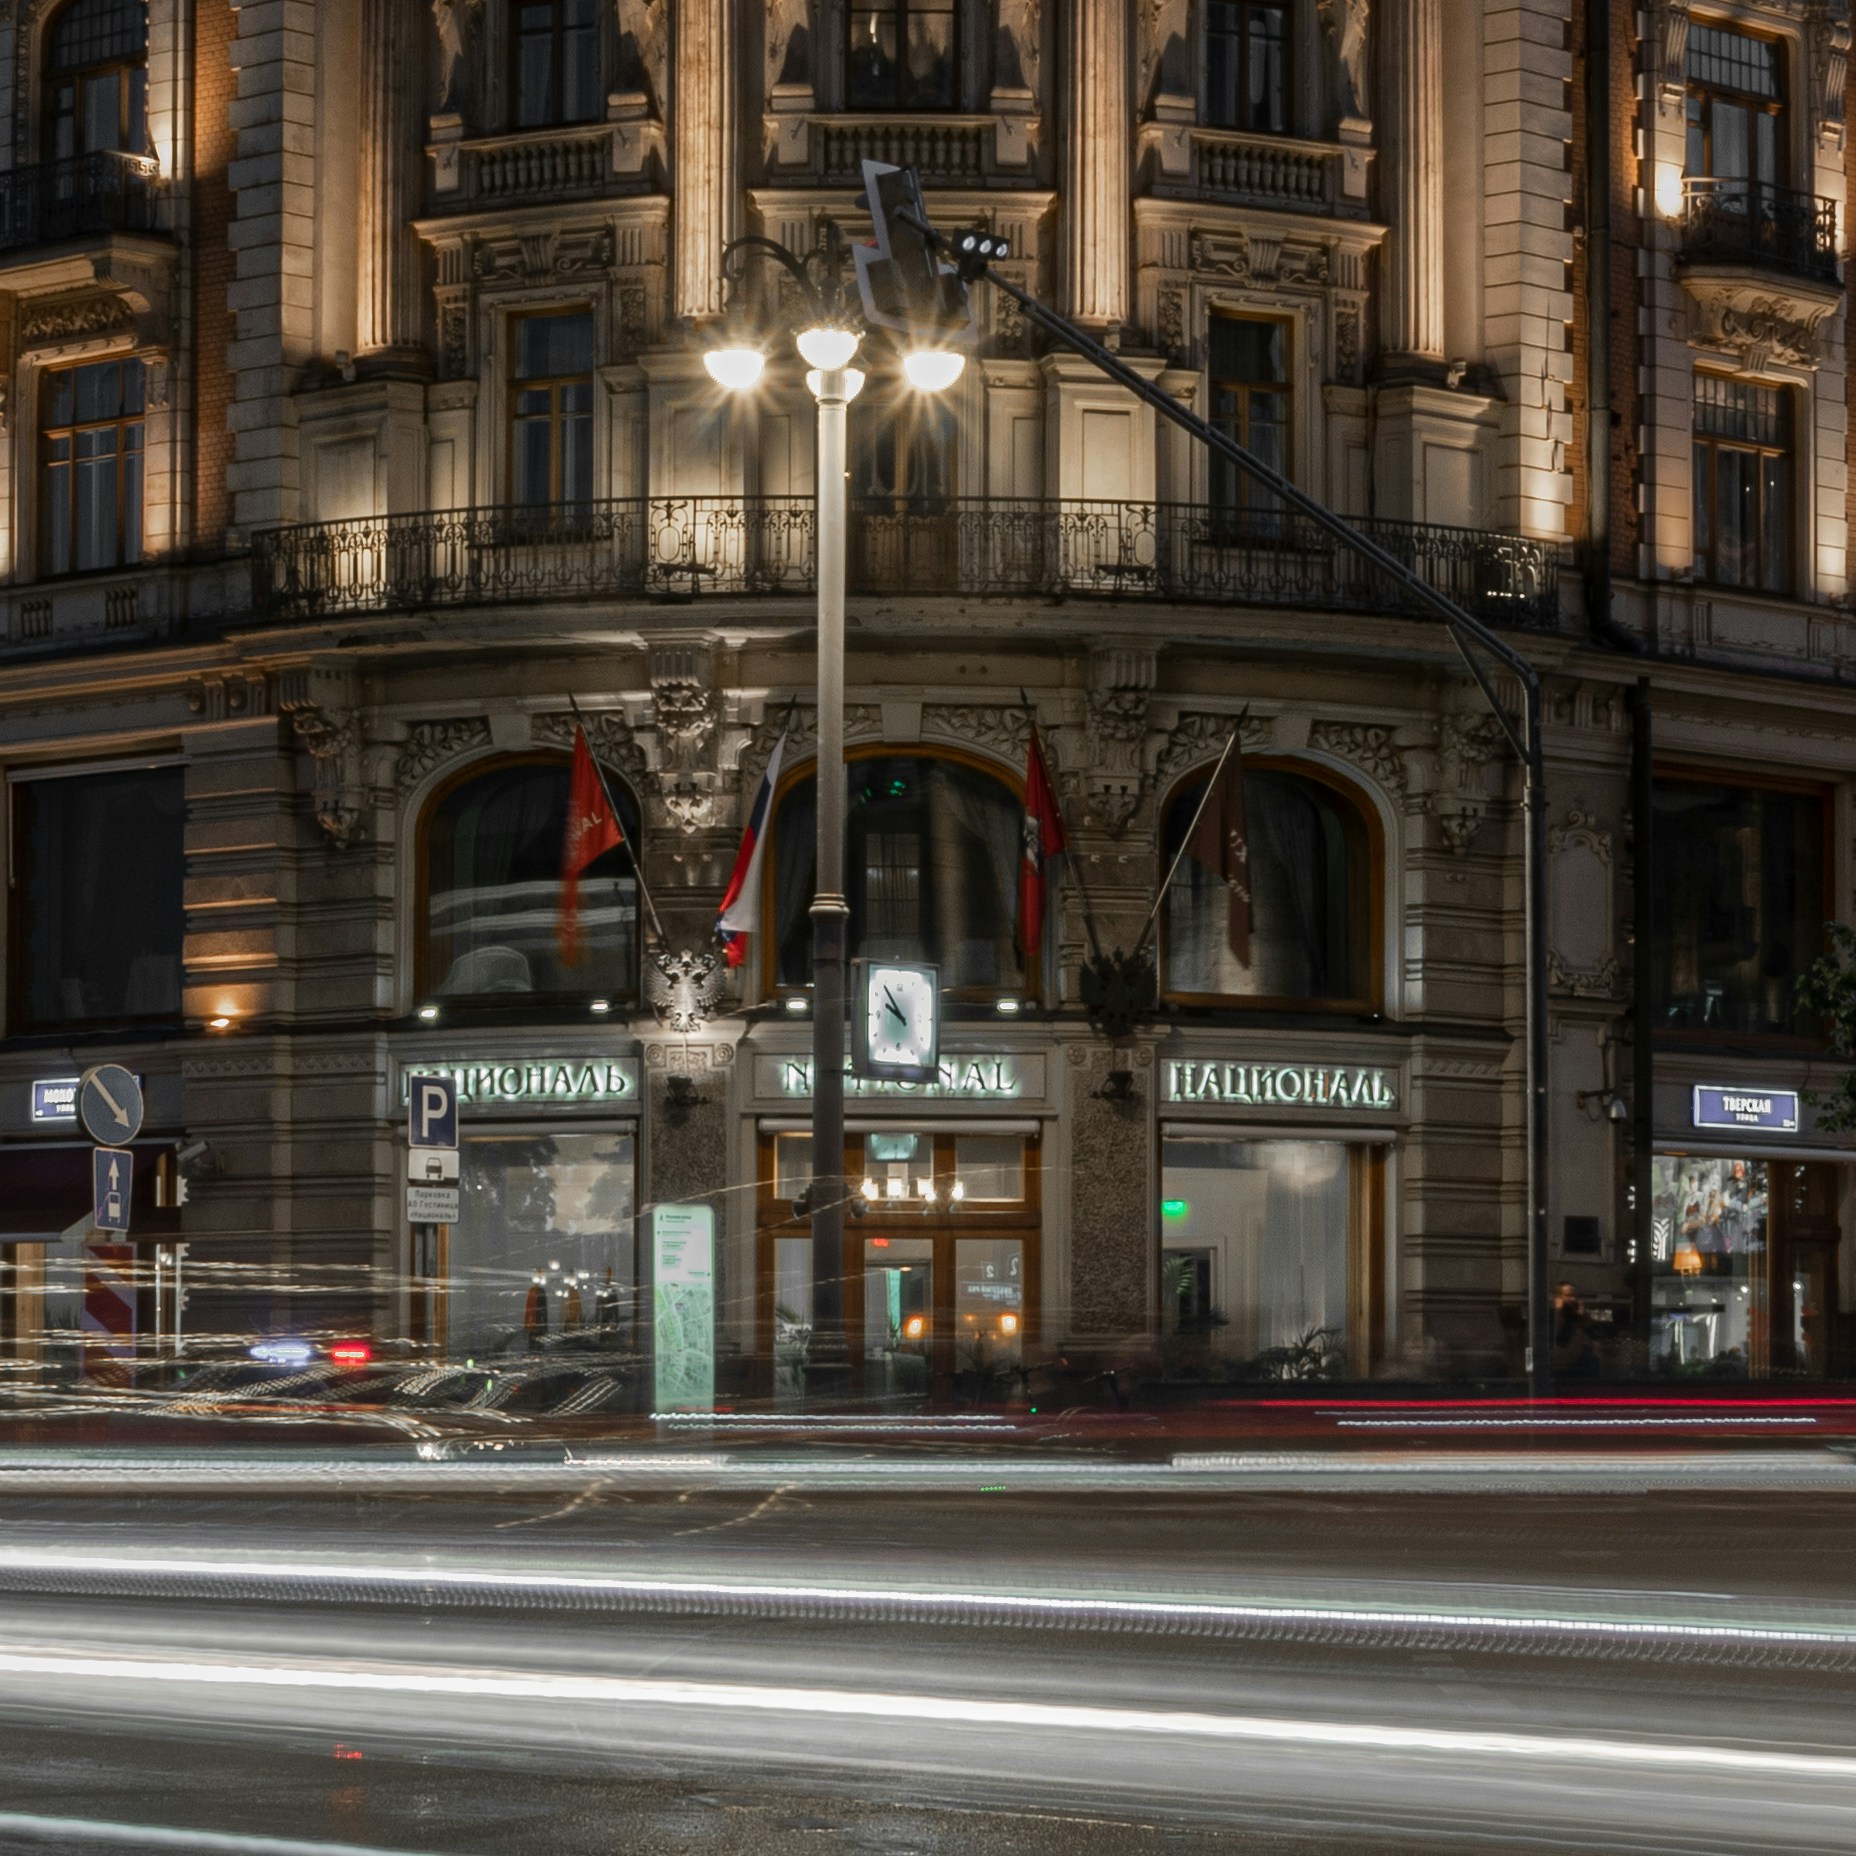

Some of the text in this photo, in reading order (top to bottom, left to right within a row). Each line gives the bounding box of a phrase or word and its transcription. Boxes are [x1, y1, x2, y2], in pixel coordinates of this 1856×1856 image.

[405, 1064, 626, 1101] ЦИОНАЛЬ
[786, 1062, 1018, 1091] NNAL
[1170, 1063, 1395, 1107] НАЦИОНАЛЬ
[1723, 1095, 1772, 1114] ТВЕРСКАЯ
